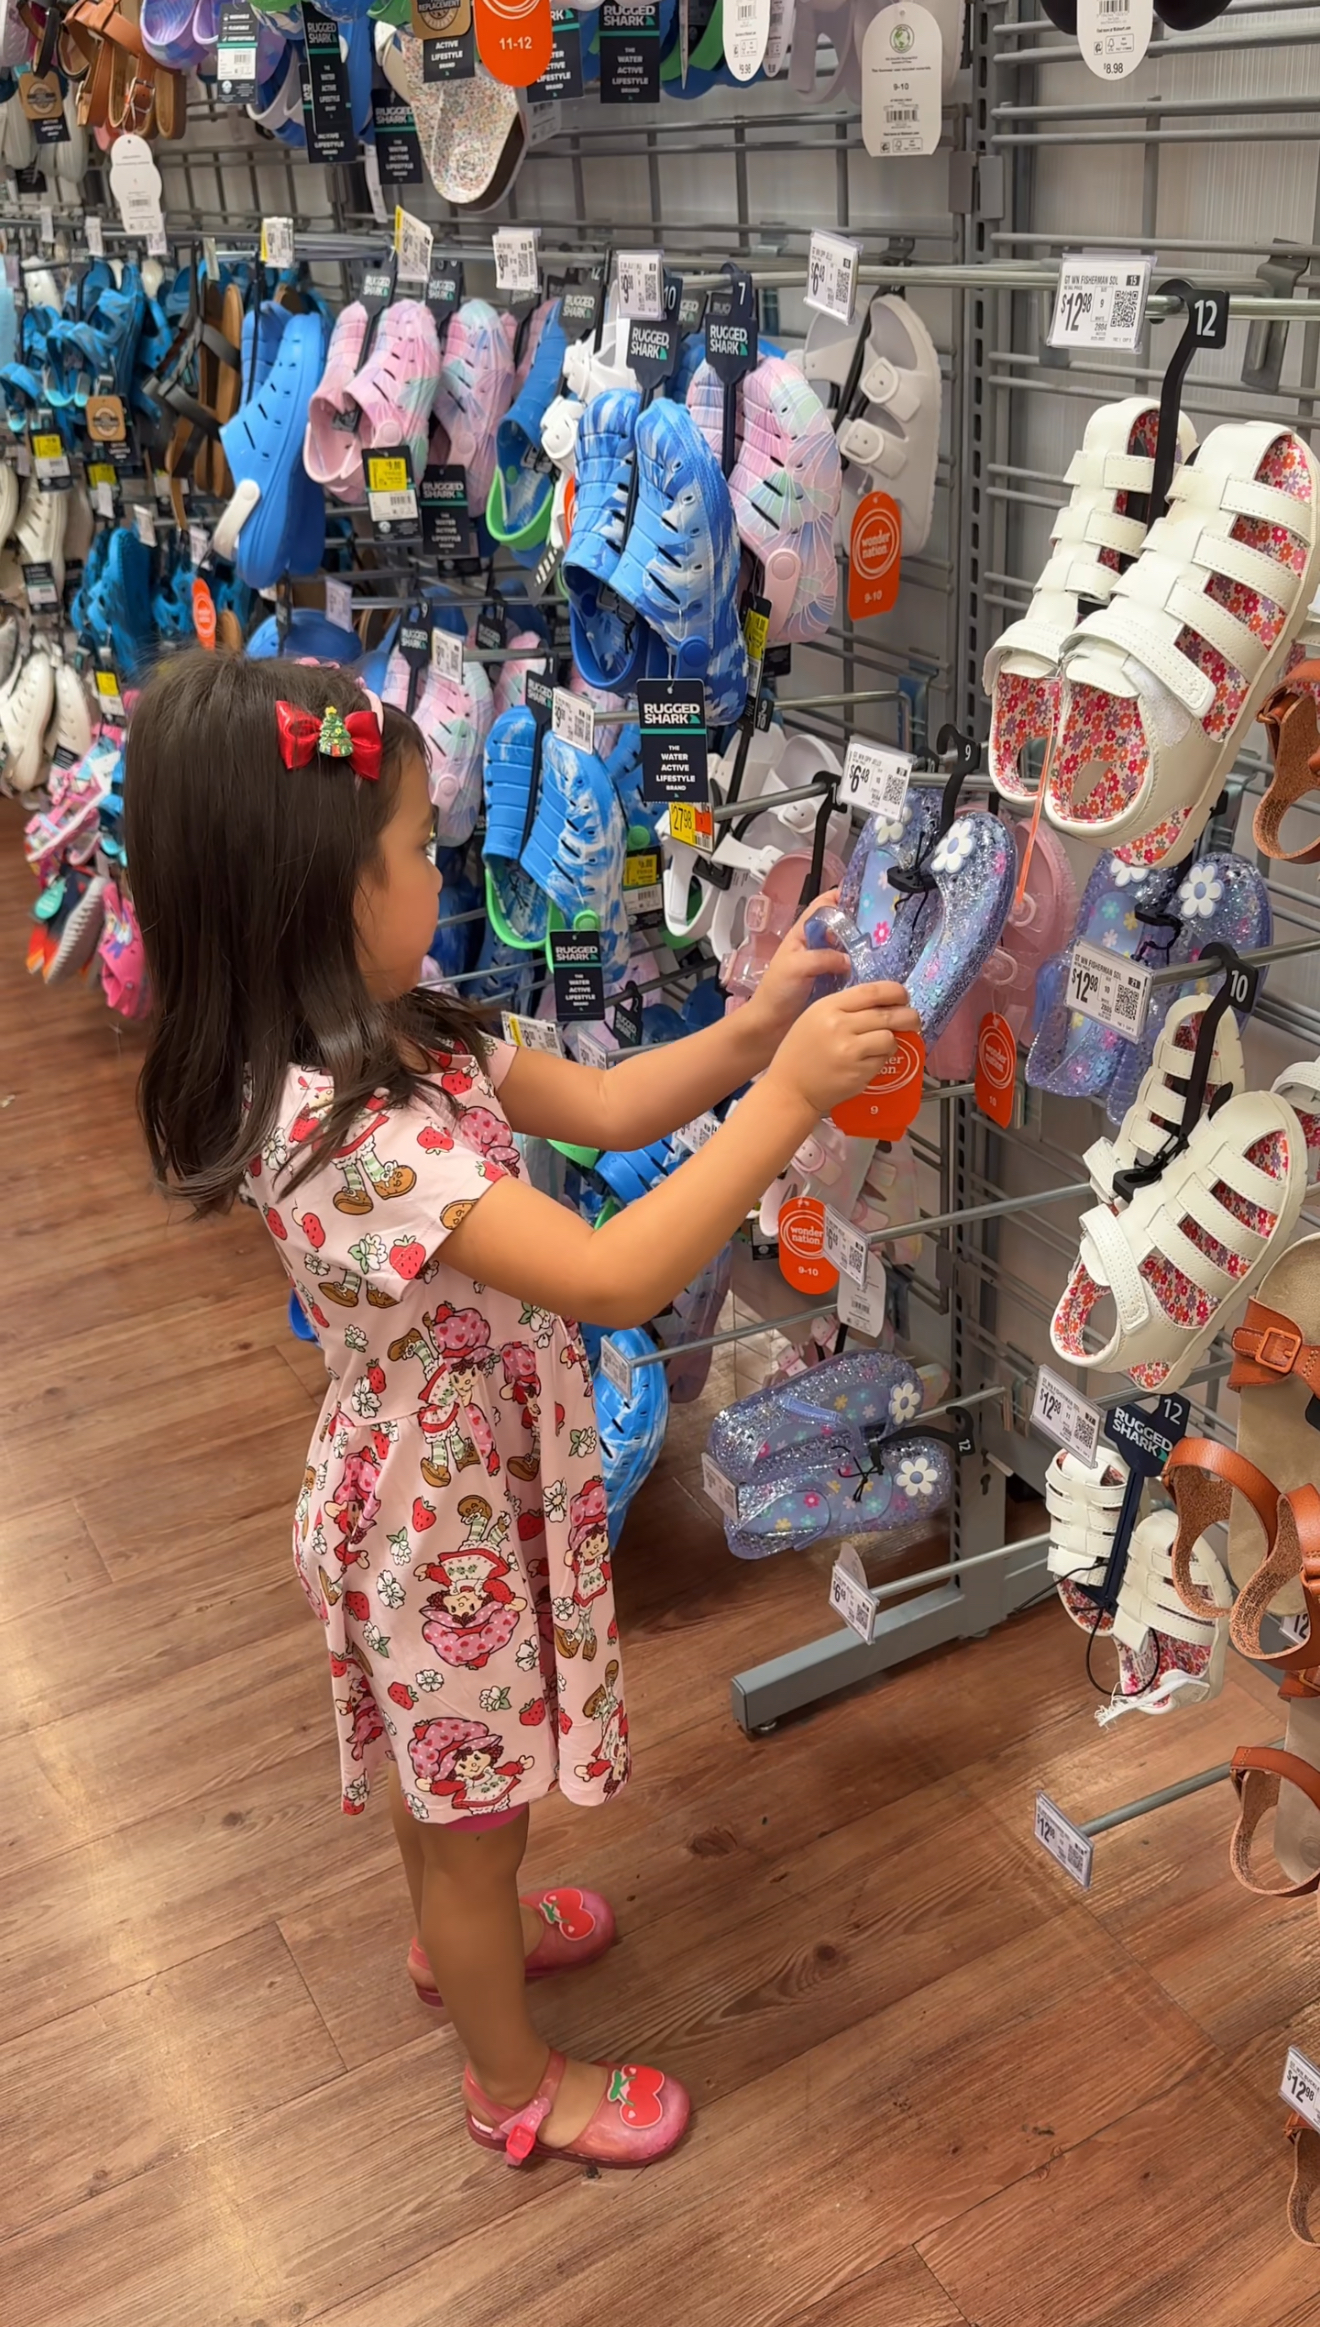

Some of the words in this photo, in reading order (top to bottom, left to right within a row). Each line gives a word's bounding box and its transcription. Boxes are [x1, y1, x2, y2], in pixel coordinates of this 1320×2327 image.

[418, 0, 460, 10] REPLACEMENT
[603, 5, 656, 16] RUGGED
[603, 15, 645, 27] SHARK
[307, 22, 337, 33] RUGGED
[308, 33, 333, 43] SHARK
[499, 36, 533, 50] 11-12
[435, 40, 459, 50] ACTIVE
[431, 50, 463, 61] LIFESTYLE
[617, 55, 643, 63] WATER
[617, 66, 644, 74] ACTIVE
[1103, 62, 1123, 74] $8.98
[612, 77, 649, 85] LIFESTYLE
[375, 106, 413, 115] RUGGED
[376, 115, 407, 124] SHARK
[1081, 275, 1109, 285] FISHERMAN
[664, 285, 676, 310] 10
[738, 281, 746, 306] 7
[565, 294, 595, 309] RUGGED
[562, 305, 586, 318] SHARK
[1194, 299, 1218, 337] 12
[632, 326, 670, 347] RUGGED
[709, 324, 748, 342] RUGGED
[631, 341, 660, 359] SHARK
[709, 338, 739, 355] SHARK
[422, 481, 464, 491] RUGGED
[423, 490, 456, 499] SHARK
[861, 528, 891, 548] wonder
[862, 545, 888, 559] nation
[864, 590, 883, 603] 9-10
[401, 628, 428, 640] RUGGED
[401, 637, 422, 649] SHARK
[643, 703, 701, 714] RUGGED
[644, 714, 689, 724] SHARK
[661, 753, 689, 761] WATER
[965, 744, 972, 761] 9
[661, 764, 689, 772] ACTIVE
[656, 774, 696, 782] LIFESTYLE
[555, 946, 598, 954] RUGGED
[556, 953, 589, 961] SHARK
[1088, 959, 1113, 977] FISHERMAN
[1230, 970, 1249, 1003] 10
[870, 1105, 879, 1115] 9
[790, 1225, 824, 1237] wonder
[792, 1234, 821, 1246] nation
[798, 1266, 819, 1277] 9-10
[1163, 1398, 1184, 1426] 12
[1114, 1406, 1174, 1452] RUGGED
[1112, 1418, 1158, 1457] SHARK
[958, 1438, 972, 1453] 12
